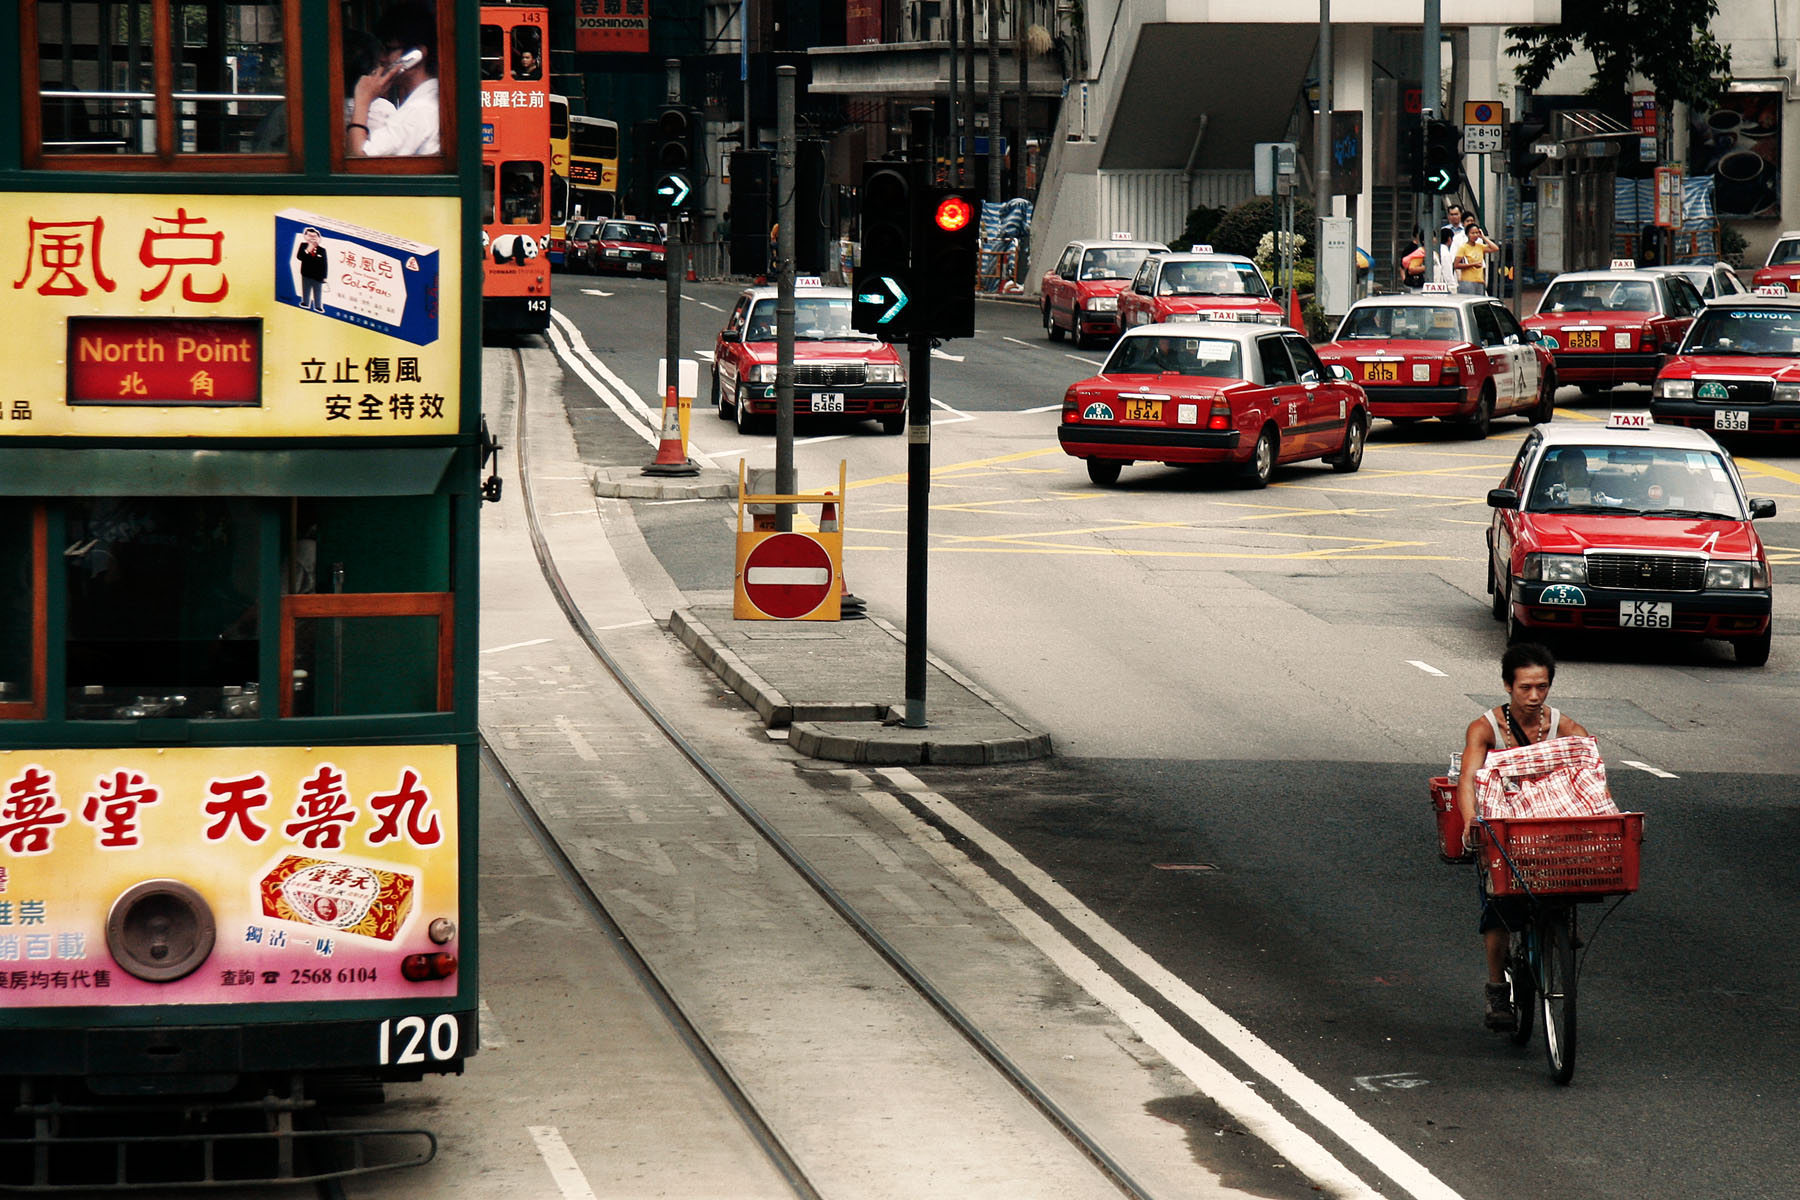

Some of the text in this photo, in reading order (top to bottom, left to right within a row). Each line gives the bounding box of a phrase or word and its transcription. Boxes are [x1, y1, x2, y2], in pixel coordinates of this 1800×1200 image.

[522, 13, 541, 23] 143
[1479, 129, 1500, 137] 8-10
[799, 278, 820, 286] TAXI
[528, 300, 547, 312] 143
[1213, 312, 1235, 320] TAXI
[1748, 312, 1792, 320] TOYOTA
[1570, 339, 1599, 348] 6203
[80, 337, 251, 363] North Point
[300, 357, 422, 384] 立止傷風
[120, 371, 214, 397] 北角
[820, 393, 836, 402] EW
[325, 393, 445, 421] 安全特效
[813, 402, 843, 412] 5466
[1136, 400, 1153, 410] LR
[1129, 410, 1159, 420] 1944
[1725, 411, 1740, 420] EV
[1613, 415, 1645, 426] TAXI
[1716, 420, 1747, 430] 6338
[1560, 590, 1567, 598] 5
[1634, 601, 1658, 614] KZ
[1622, 614, 1670, 627] 7868
[0, 767, 440, 852] 喜堂 天喜丸
[221, 967, 377, 986] 查詢 2568 6104
[378, 1014, 459, 1065] 120
